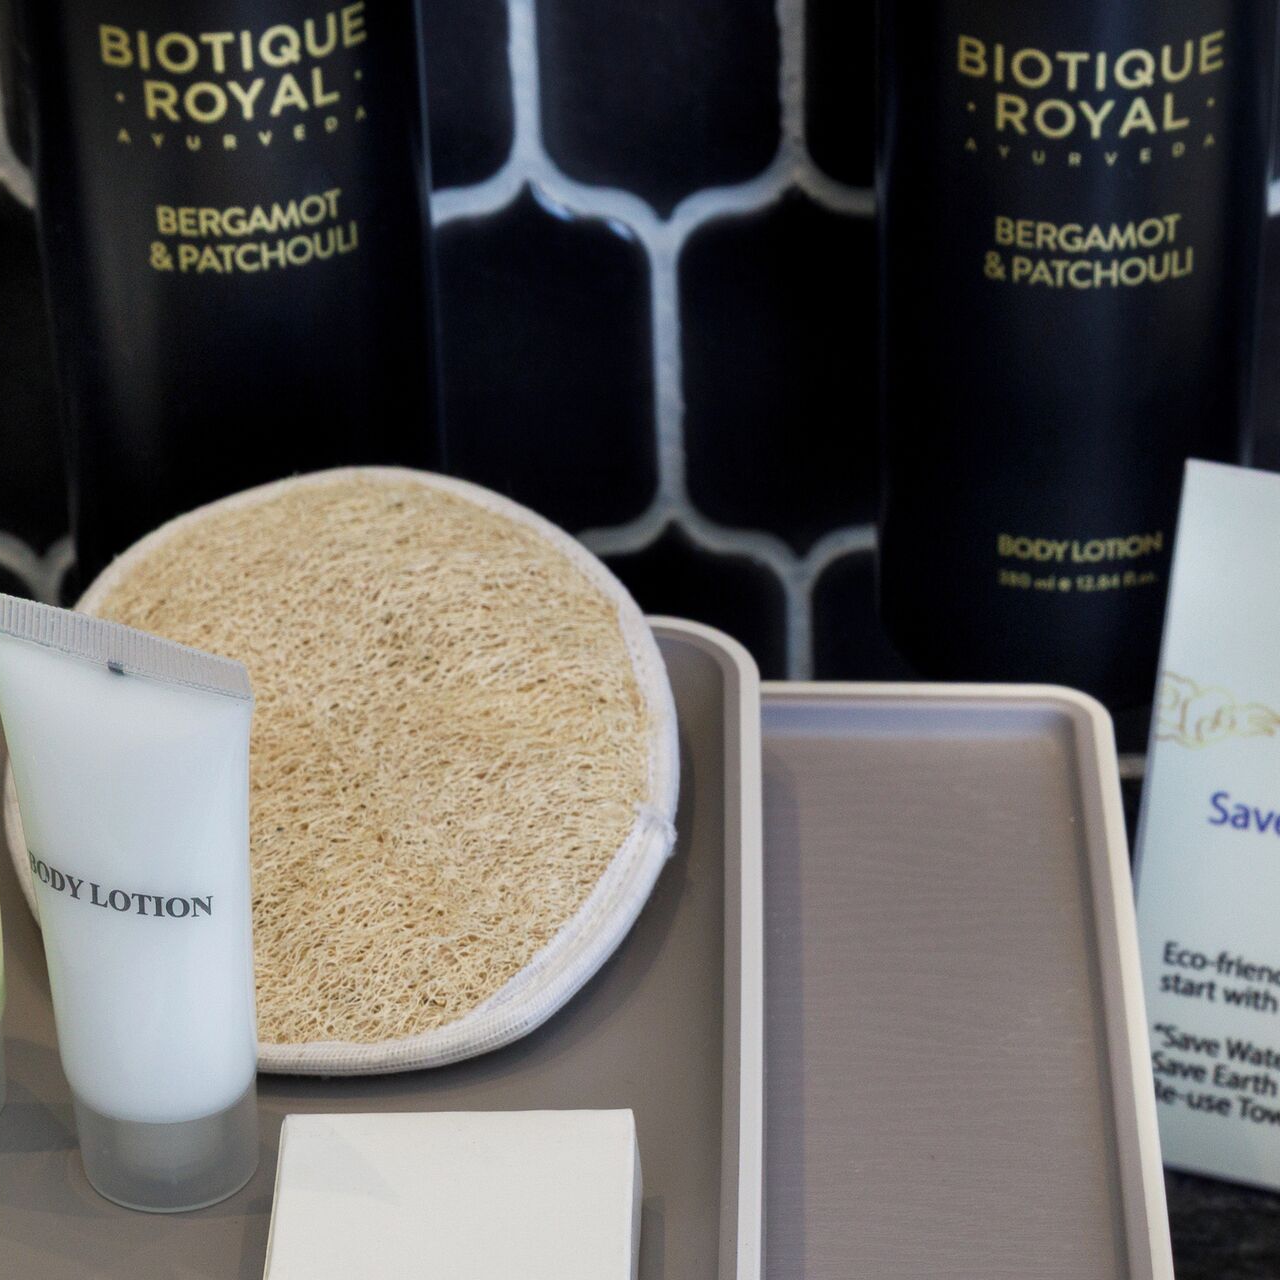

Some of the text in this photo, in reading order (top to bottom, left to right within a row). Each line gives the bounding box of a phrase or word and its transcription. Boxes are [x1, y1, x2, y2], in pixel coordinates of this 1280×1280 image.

[99, 2, 367, 74] BIOTIQUE
[957, 30, 1225, 92] BIOTIQUE
[144, 67, 340, 123] ROYAL
[995, 92, 1190, 140] ROYAL
[117, 106, 368, 151] AYURVEDA
[964, 133, 1216, 167] AYURVEDA
[156, 189, 342, 237] BERGAMOT
[995, 212, 1182, 253] BERGAMOT
[149, 221, 358, 274] & PATCHOULI
[983, 247, 1193, 289] & PATCHOULI
[997, 530, 1163, 563] BODY LOTION
[28, 850, 214, 918] BODY LOTION
[1159, 971, 1215, 1001] start
[1222, 987, 1278, 1015] with
[1152, 1050, 1279, 1097] Save Earth
